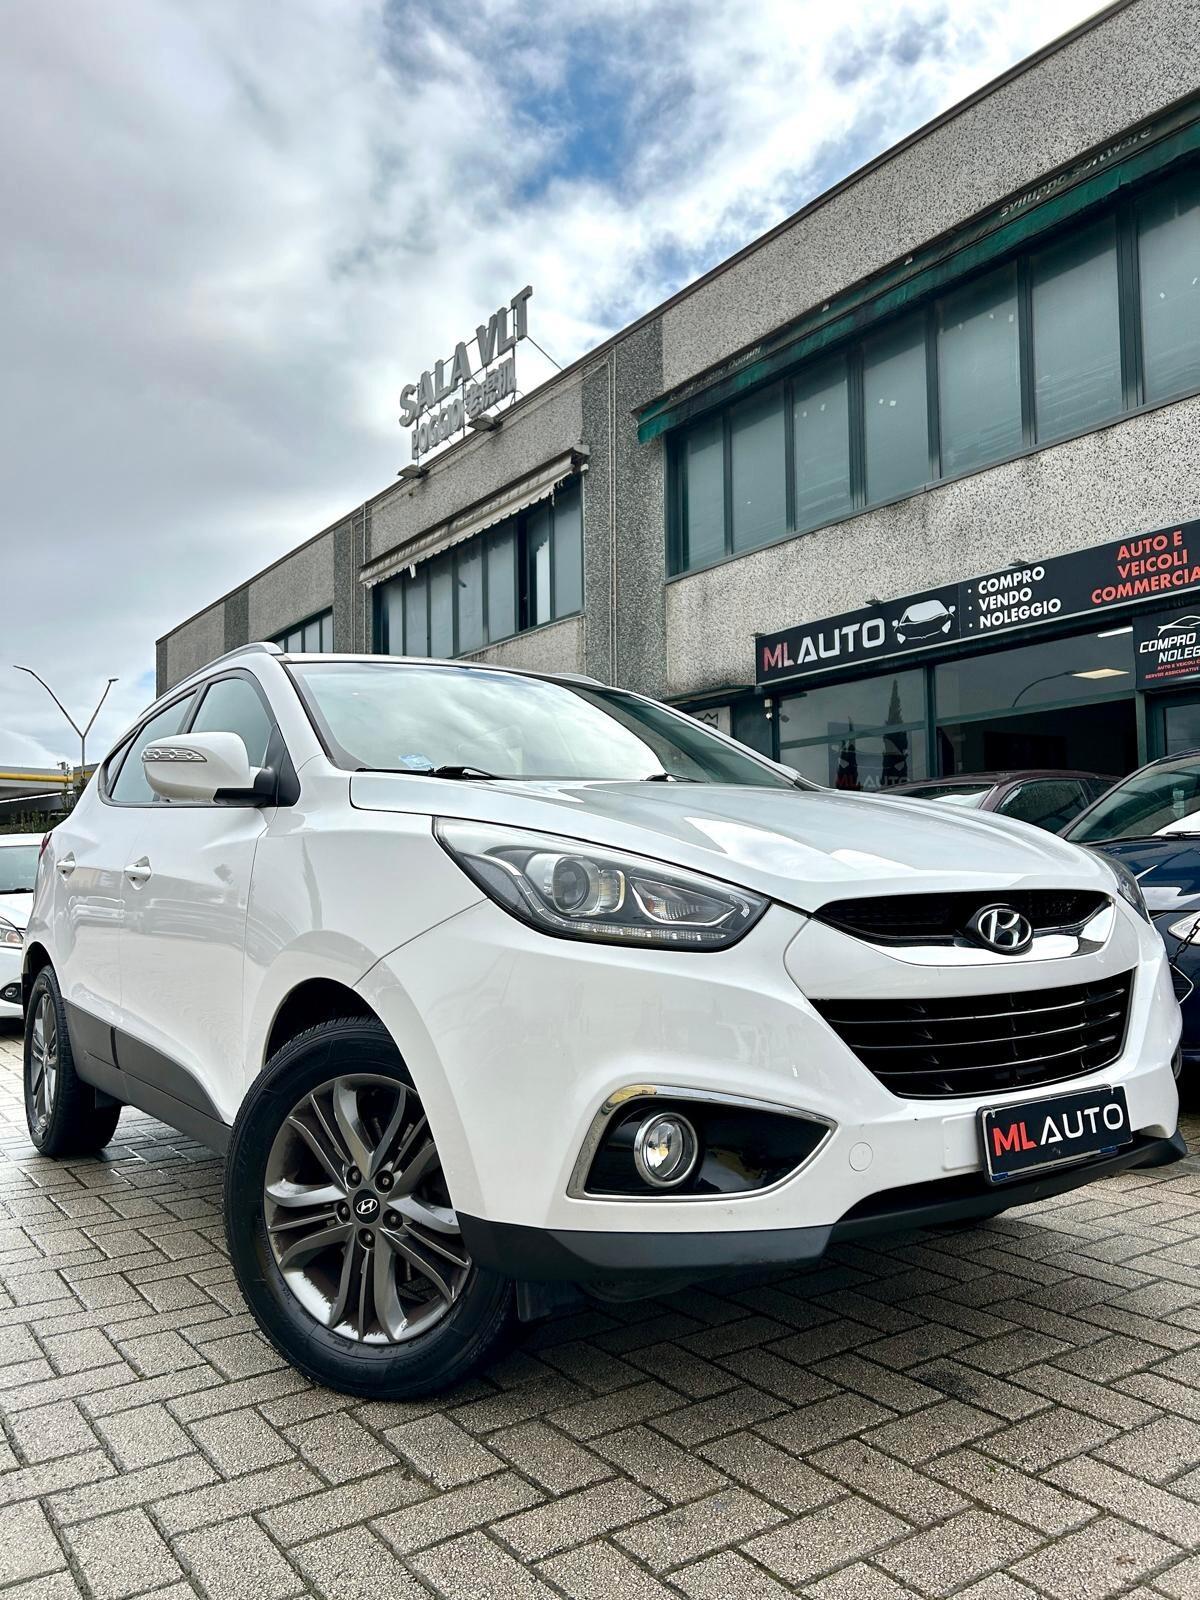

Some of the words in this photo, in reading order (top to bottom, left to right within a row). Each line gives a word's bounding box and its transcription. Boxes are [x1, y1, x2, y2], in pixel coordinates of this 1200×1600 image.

[399, 341, 471, 428] SALA
[476, 285, 533, 367] VLT
[1117, 535, 1168, 560] AUTO
[1173, 531, 1183, 546] E
[1117, 549, 1189, 579] VEICOLI
[978, 566, 1046, 596] COMPRO
[979, 587, 1033, 612] VENDO
[979, 598, 1062, 630] NOLEGGIO
[763, 641, 796, 673] ML
[797, 617, 885, 664] AUTO
[1139, 632, 1197, 654] COMPRO
[992, 1121, 1037, 1157] ML
[1040, 1103, 1124, 1146] AUTO
